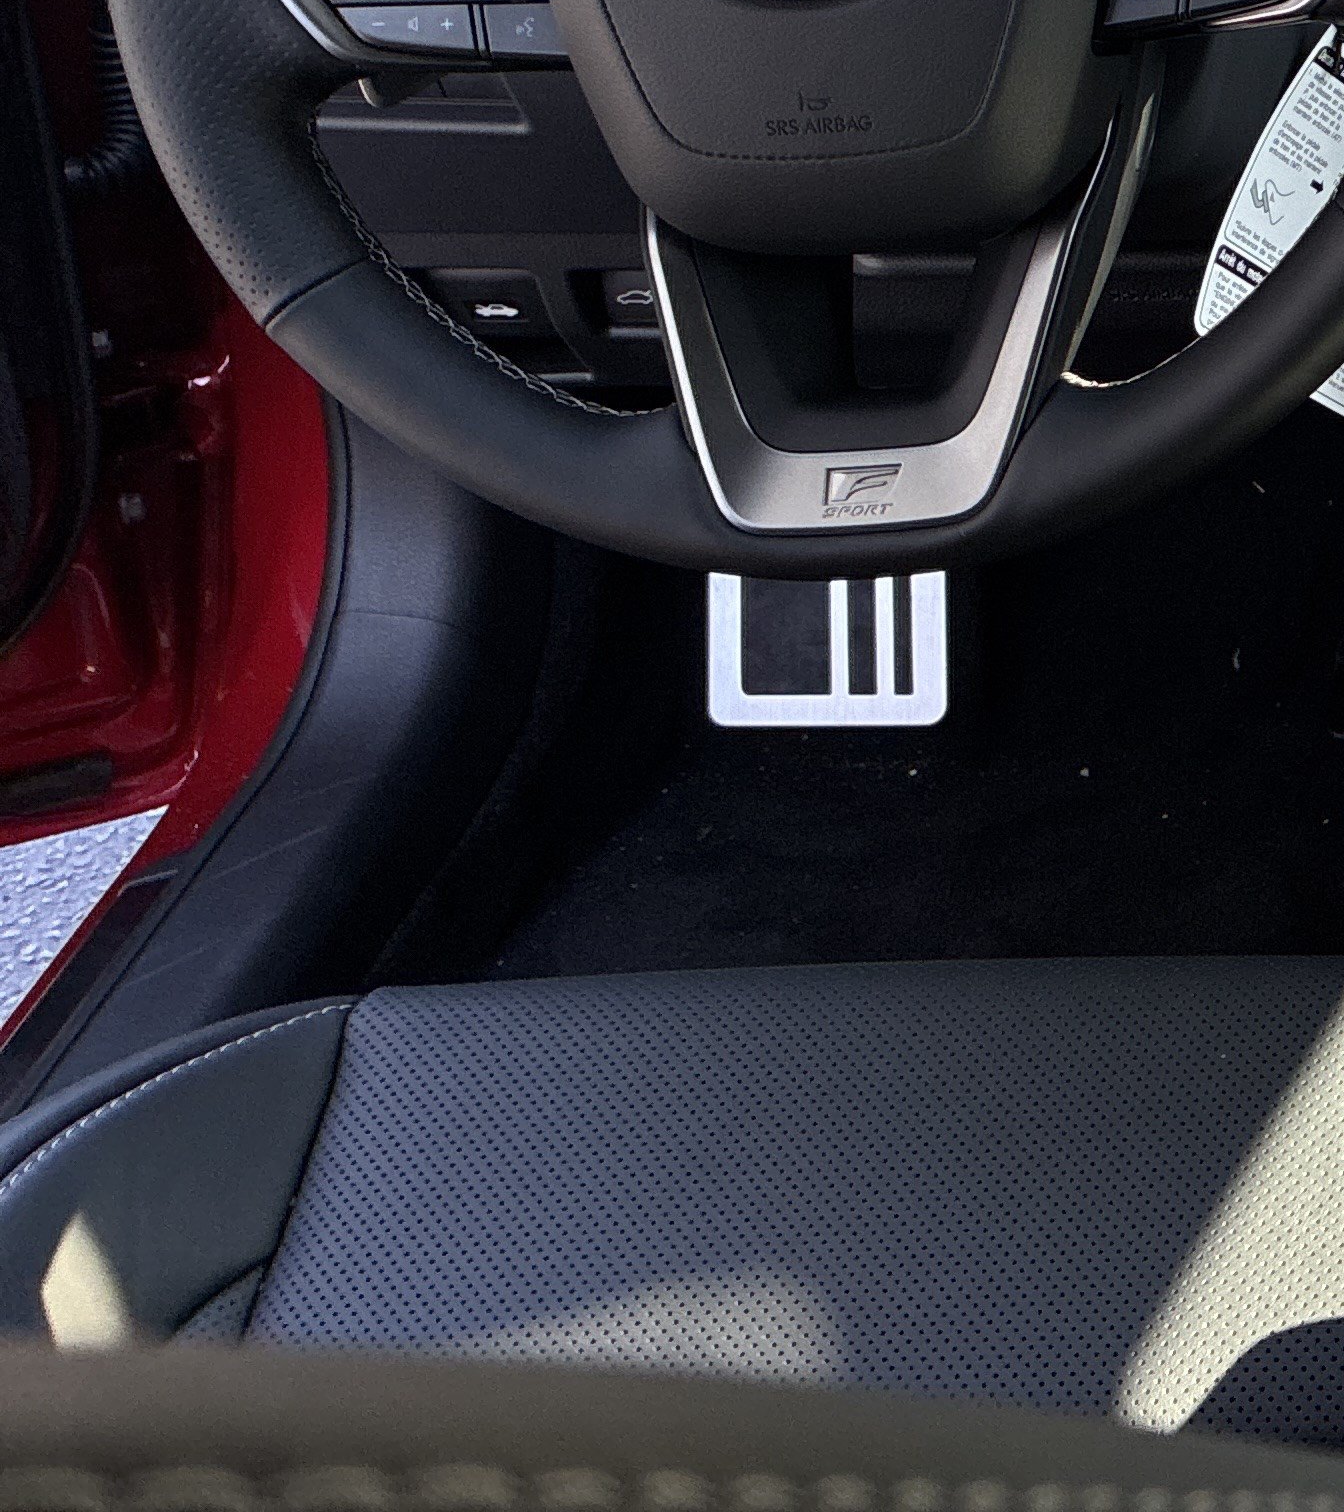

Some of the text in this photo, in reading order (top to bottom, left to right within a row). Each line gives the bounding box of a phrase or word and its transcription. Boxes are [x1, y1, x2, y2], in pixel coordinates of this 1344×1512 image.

[765, 114, 873, 136] SRS AIRBAG
[822, 501, 894, 519] SPORT
